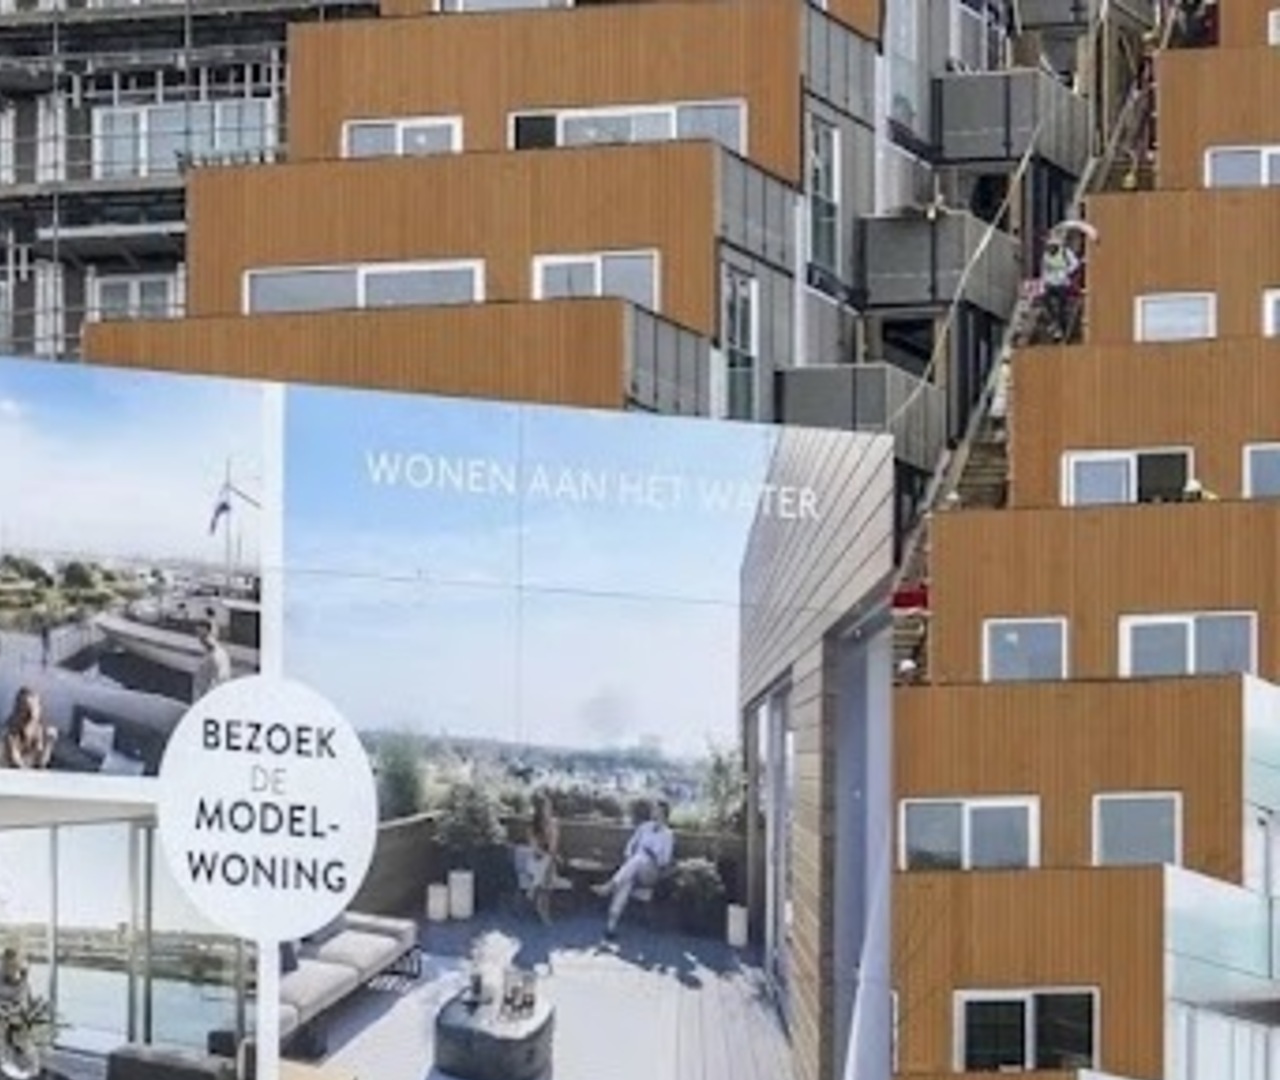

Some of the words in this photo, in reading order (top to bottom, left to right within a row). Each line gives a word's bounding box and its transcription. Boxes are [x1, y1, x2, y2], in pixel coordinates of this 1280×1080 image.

[366, 451, 515, 496] WONEN
[529, 466, 607, 503] AAN
[619, 475, 683, 508] HET
[702, 478, 819, 520] WATER
[203, 719, 337, 758] BEZOEK
[250, 766, 287, 795] DE
[194, 798, 340, 838] MODEL-
[186, 850, 348, 894] WONING
